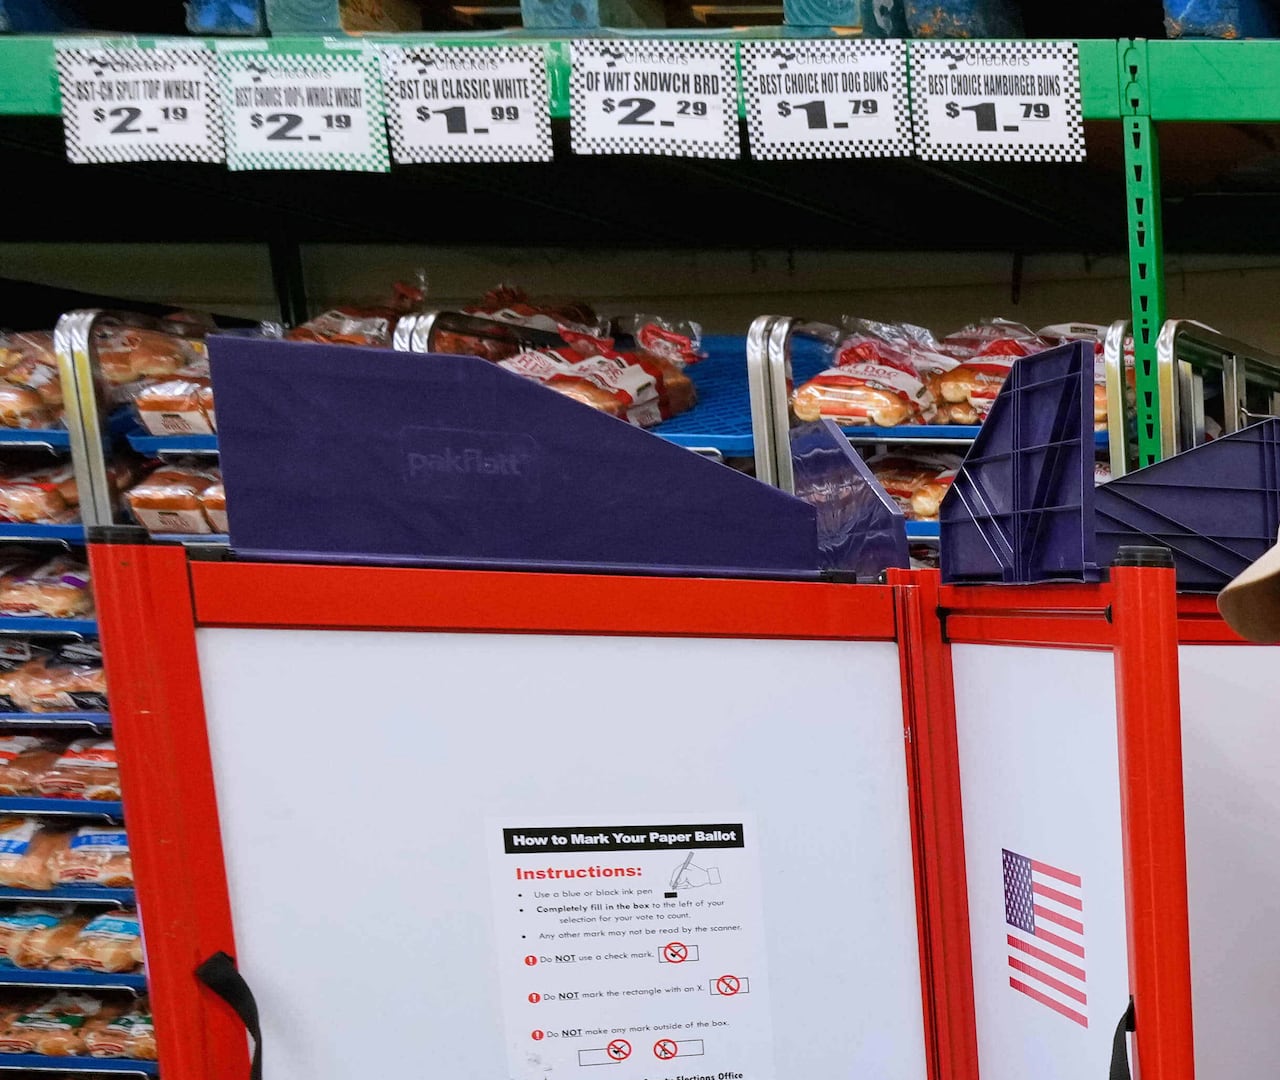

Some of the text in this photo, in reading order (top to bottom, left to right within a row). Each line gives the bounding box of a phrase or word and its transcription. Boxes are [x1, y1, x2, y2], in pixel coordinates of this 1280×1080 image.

[796, 51, 858, 65] Checkers
[965, 52, 1030, 66] Checkers
[163, 80, 201, 100] WHEAT
[400, 78, 530, 99] BST CH CLASSIC WHITE
[604, 72, 630, 92] WHT
[634, 72, 690, 94] SNDWCH
[694, 74, 719, 95] BRD
[759, 71, 889, 95] BEST CHOICE HOT DOG BUNS
[928, 74, 1061, 97] BEST CHOICE HAMBURGER BUNS
[306, 87, 333, 107] WHOLE
[334, 88, 362, 108] WHEAT
[512, 830, 737, 847] How to Mark Your Paper Ballot
[515, 865, 642, 881] Instructions:
[534, 891, 551, 899] Use
[622, 888, 634, 896] ink
[637, 889, 653, 897] pen
[536, 904, 588, 913] Completely
[590, 903, 602, 911] fill
[605, 903, 615, 911] in
[617, 902, 631, 910] the
[633, 902, 650, 910] box
[663, 901, 676, 909] the
[679, 900, 693, 908] left
[695, 899, 704, 907] of
[707, 900, 725, 909] your
[559, 916, 597, 924] selection
[615, 915, 633, 924] your
[636, 913, 654, 921] vote
[667, 912, 692, 920] count.
[558, 930, 580, 939] other
[583, 930, 605, 938] mark
[608, 930, 626, 938] may
[682, 927, 693, 935] by
[555, 954, 576, 963] NOT
[604, 952, 628, 960] check
[630, 951, 655, 959] mark.
[558, 992, 580, 1001] NOT
[606, 989, 620, 997] the
[622, 986, 662, 997] rectangle
[561, 1029, 583, 1038] NOT
[585, 1027, 608, 1035] make
[629, 1024, 651, 1032] mark
[653, 1022, 683, 1031] outside
[685, 1021, 694, 1029] of
[711, 1019, 730, 1027] box.
[718, 1071, 744, 1080] Office
